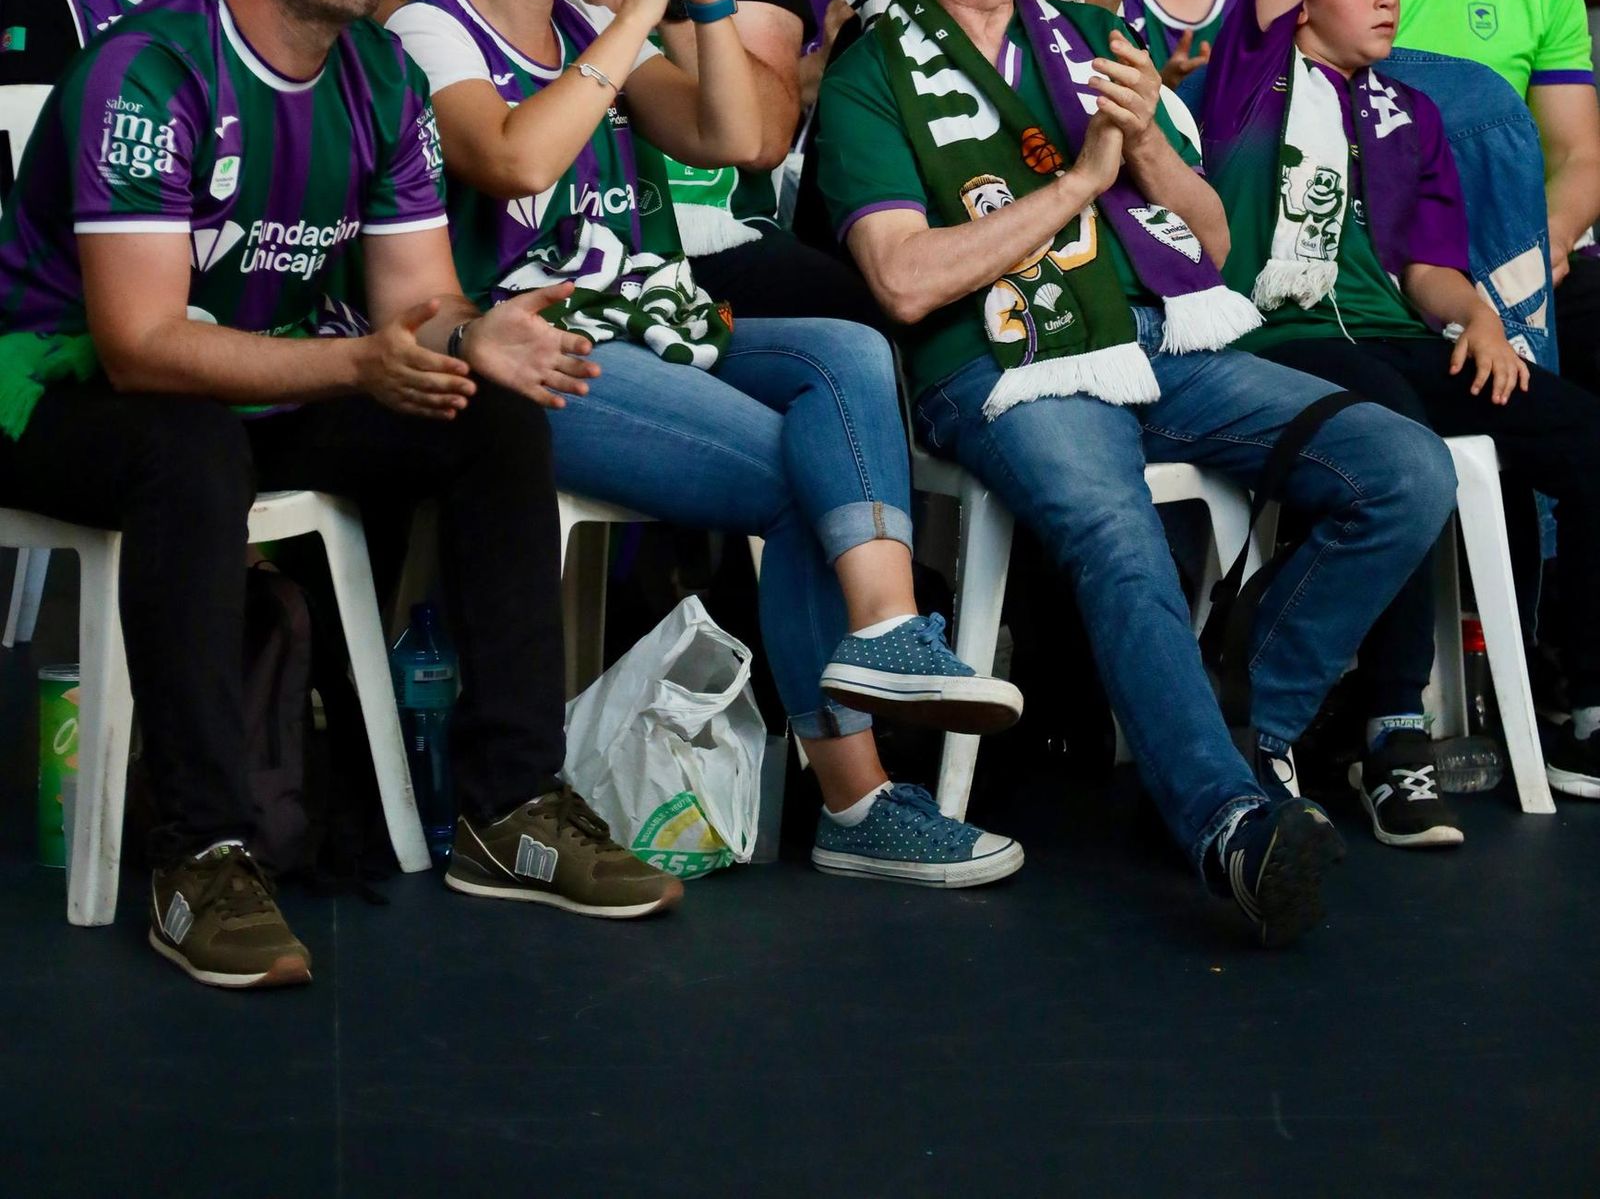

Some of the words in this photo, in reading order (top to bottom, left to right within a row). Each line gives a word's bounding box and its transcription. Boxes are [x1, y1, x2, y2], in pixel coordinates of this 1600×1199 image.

[106, 96, 144, 113] sabor
[99, 128, 175, 179] laga
[247, 216, 360, 247] Fundación
[240, 244, 327, 280] Unicaja
